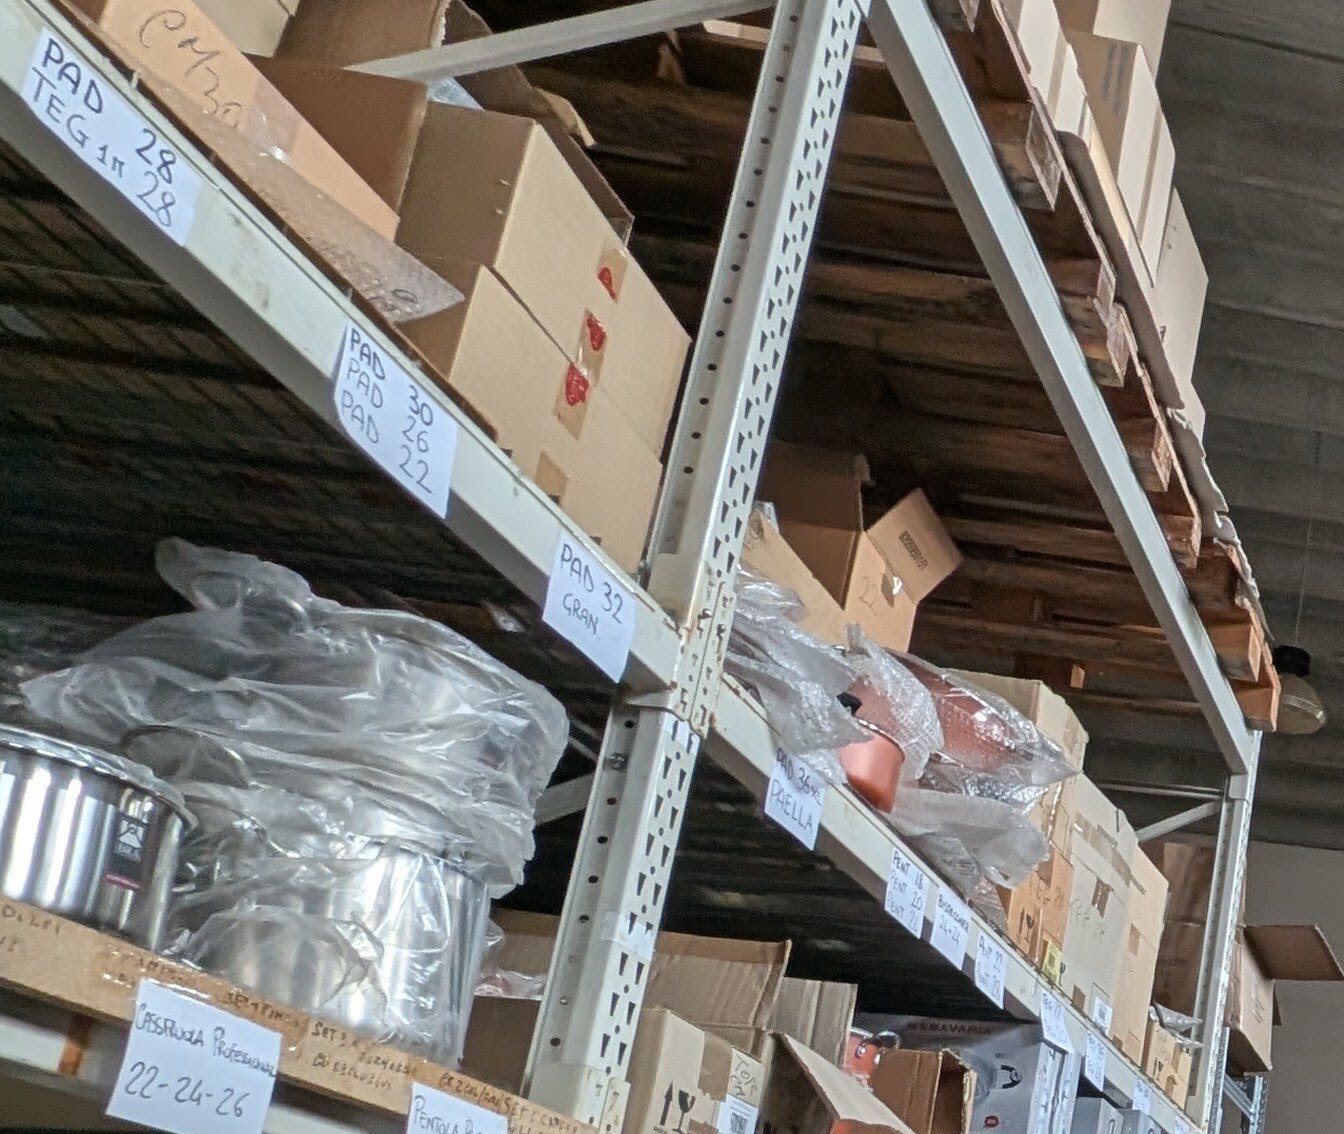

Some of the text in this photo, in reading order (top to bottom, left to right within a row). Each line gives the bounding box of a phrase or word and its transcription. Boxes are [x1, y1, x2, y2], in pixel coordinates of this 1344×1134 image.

[32, 66, 90, 149] TEG
[137, 170, 176, 228] 28
[42, 38, 177, 185] PAD 28
[347, 357, 430, 453] PAD 26
[350, 327, 434, 426] PAD 30
[341, 389, 433, 494] PAD 22
[560, 543, 623, 624] PAD 32
[770, 778, 813, 835] PAELLA
[776, 747, 794, 780] PAD
